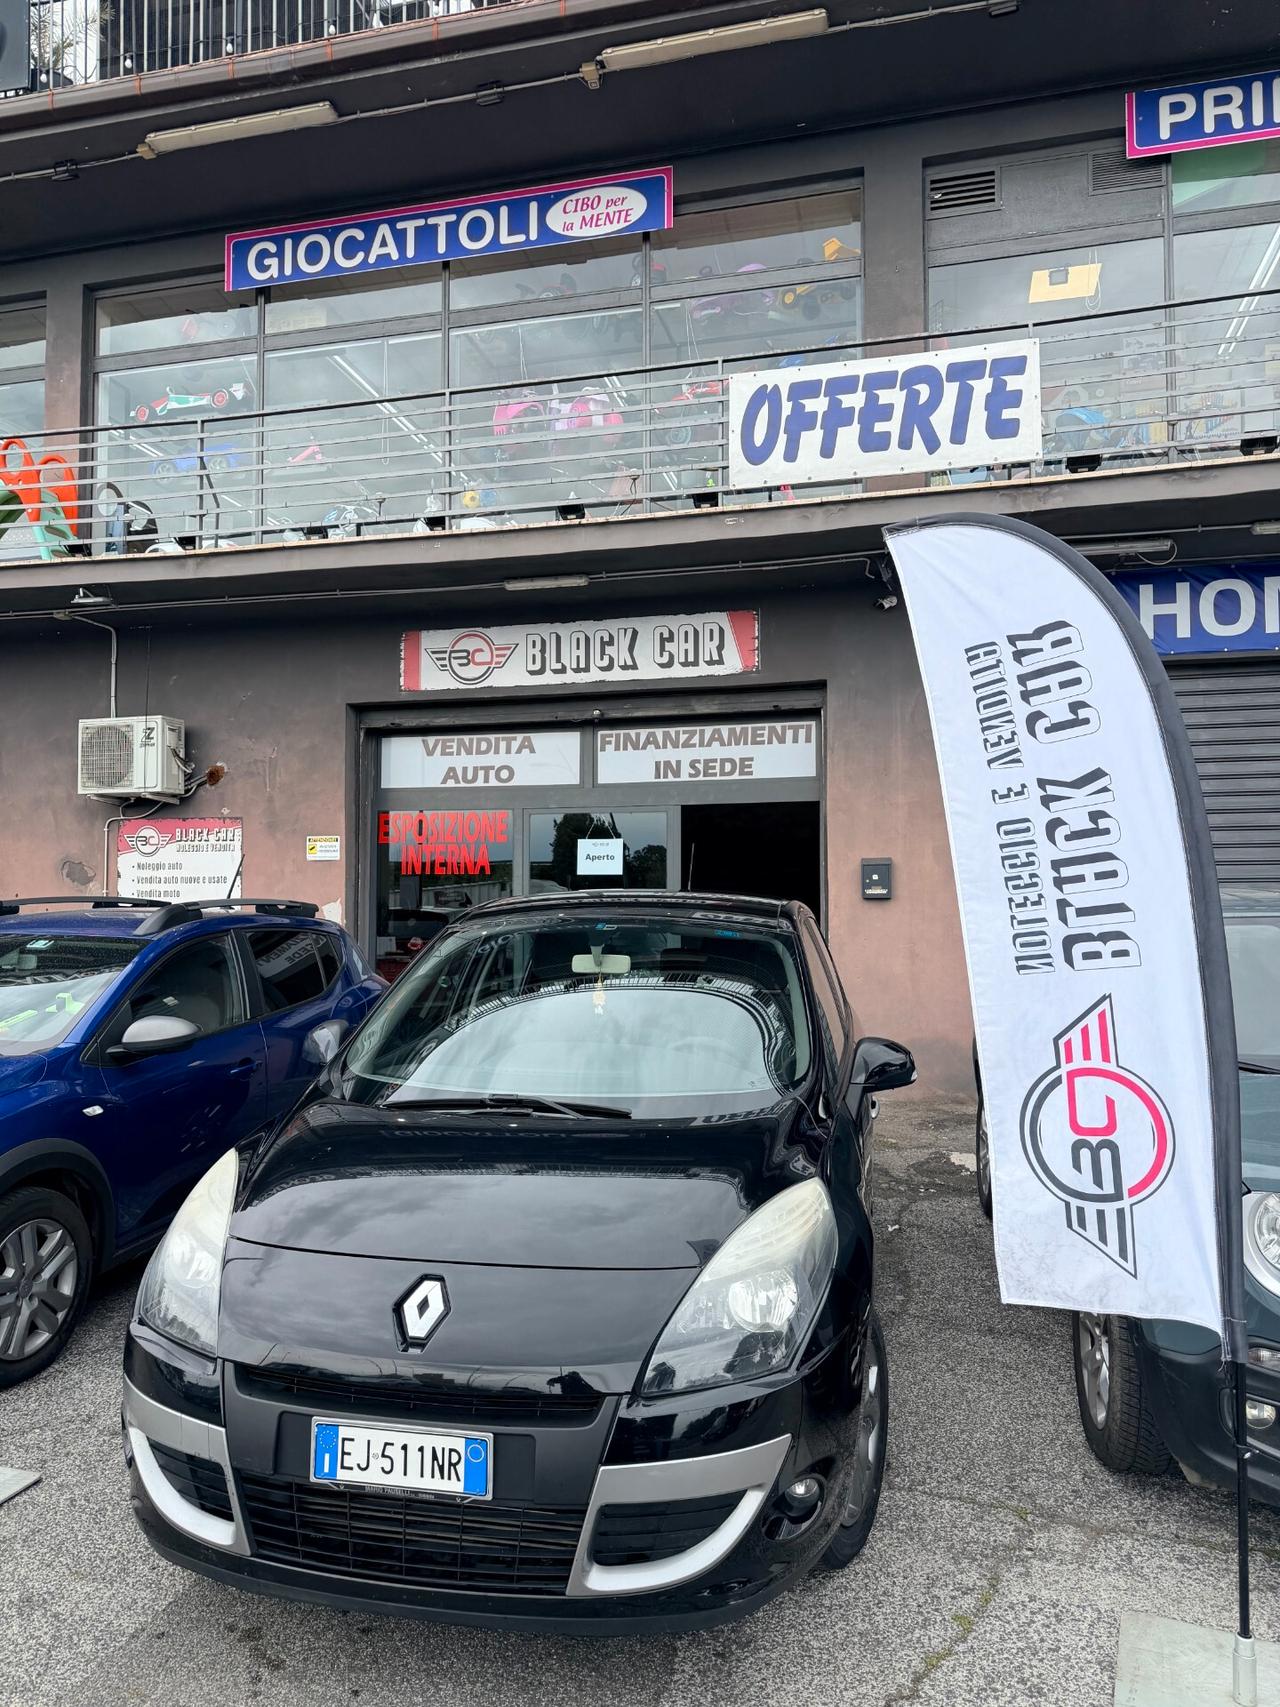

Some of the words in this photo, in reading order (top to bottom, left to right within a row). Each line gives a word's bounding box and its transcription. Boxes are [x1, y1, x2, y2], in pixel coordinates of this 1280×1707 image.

[1158, 76, 1280, 140] PRI
[561, 194, 602, 216] CIBO
[604, 194, 629, 211] per
[561, 220, 574, 233] la
[578, 208, 635, 231] MENTE
[246, 201, 538, 281] GIOCATTOLI
[739, 353, 1028, 467] OFFERTE
[526, 627, 639, 676] BLACK
[653, 621, 725, 669] CAR
[422, 735, 536, 757] VENDITA
[600, 723, 813, 752] FINANZIAMENTI
[440, 764, 515, 784] AUTO
[654, 759, 681, 780] IN
[688, 756, 754, 779] SEDE
[176, 827, 209, 843] BLACK
[213, 827, 236, 842] CAR
[378, 810, 508, 844] ESPOSIZIONE
[137, 862, 166, 871] Noleggio
[168, 862, 183, 870] auto
[401, 844, 491, 875] INTERNA
[585, 853, 615, 862] Aperto
[137, 875, 162, 884] Vendita
[163, 876, 179, 884] auto
[180, 876, 200, 884] nuove
[208, 876, 227, 884] usate
[137, 889, 162, 898] Vendita
[163, 890, 180, 898] moto
